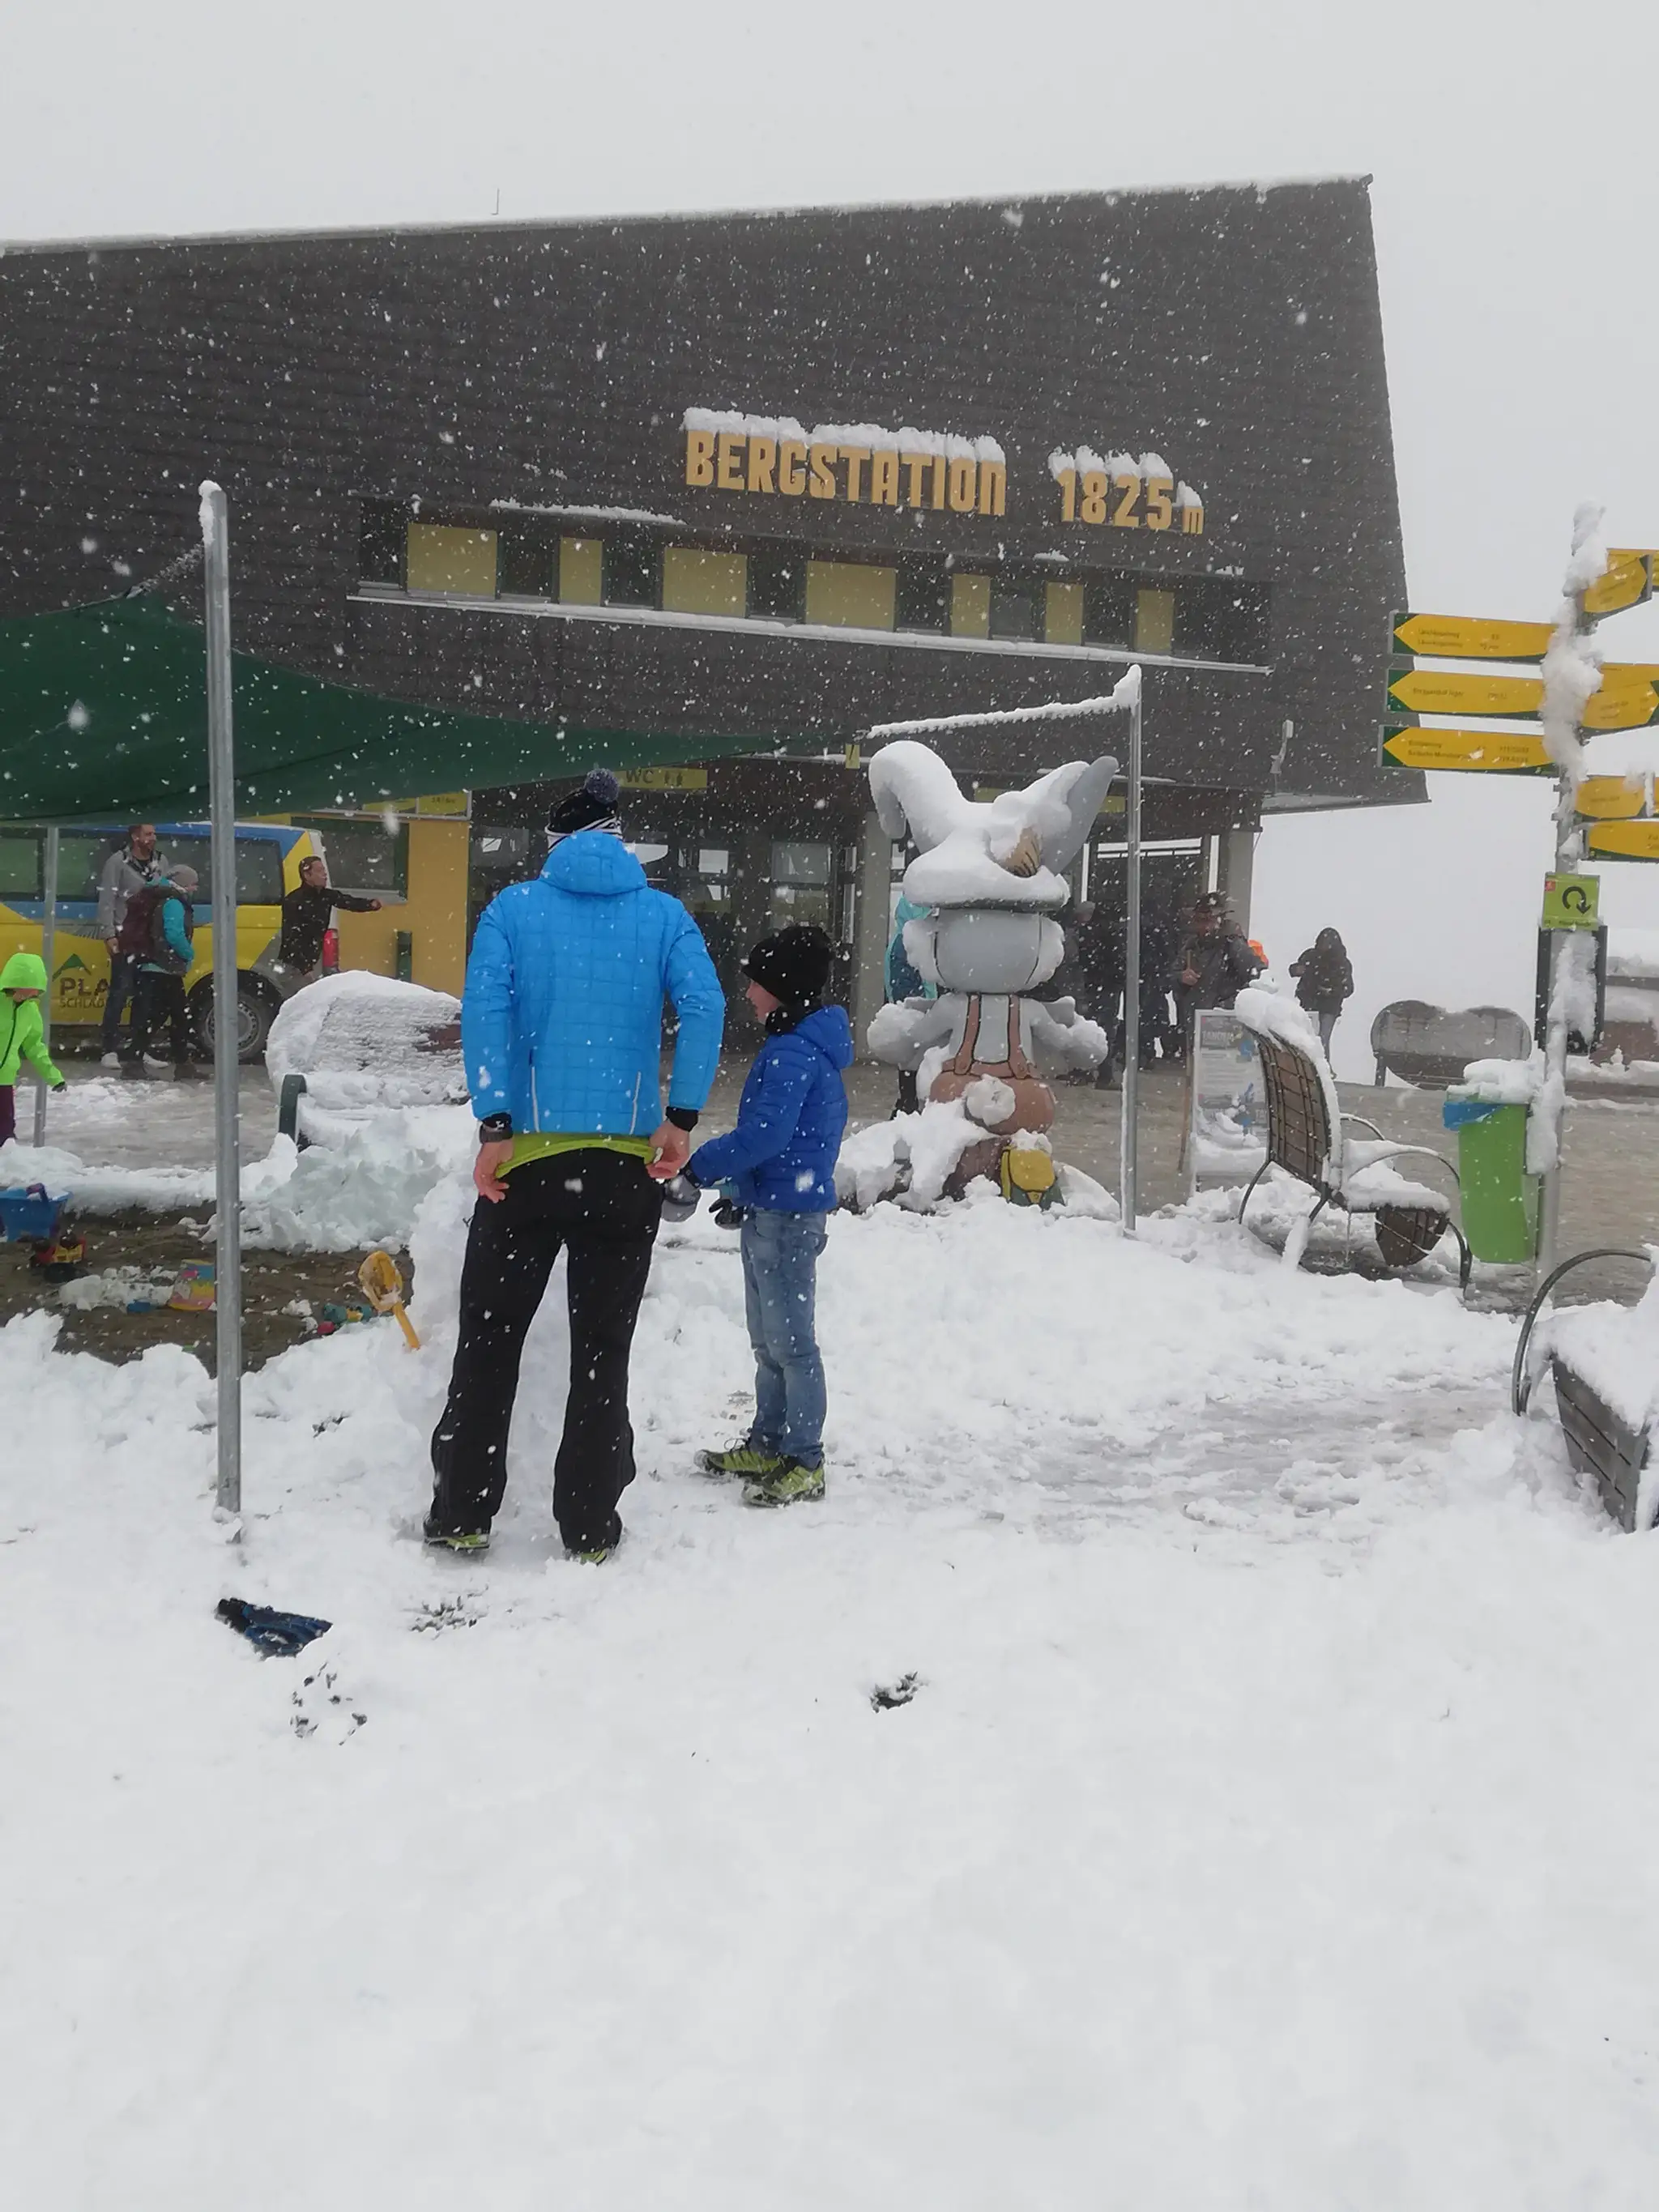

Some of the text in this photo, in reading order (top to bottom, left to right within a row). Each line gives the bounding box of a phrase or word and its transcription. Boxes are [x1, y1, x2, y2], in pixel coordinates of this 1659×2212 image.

[684, 429, 1007, 516] BERGSTATION
[625, 769, 654, 784] WC
[59, 977, 109, 996] PLA
